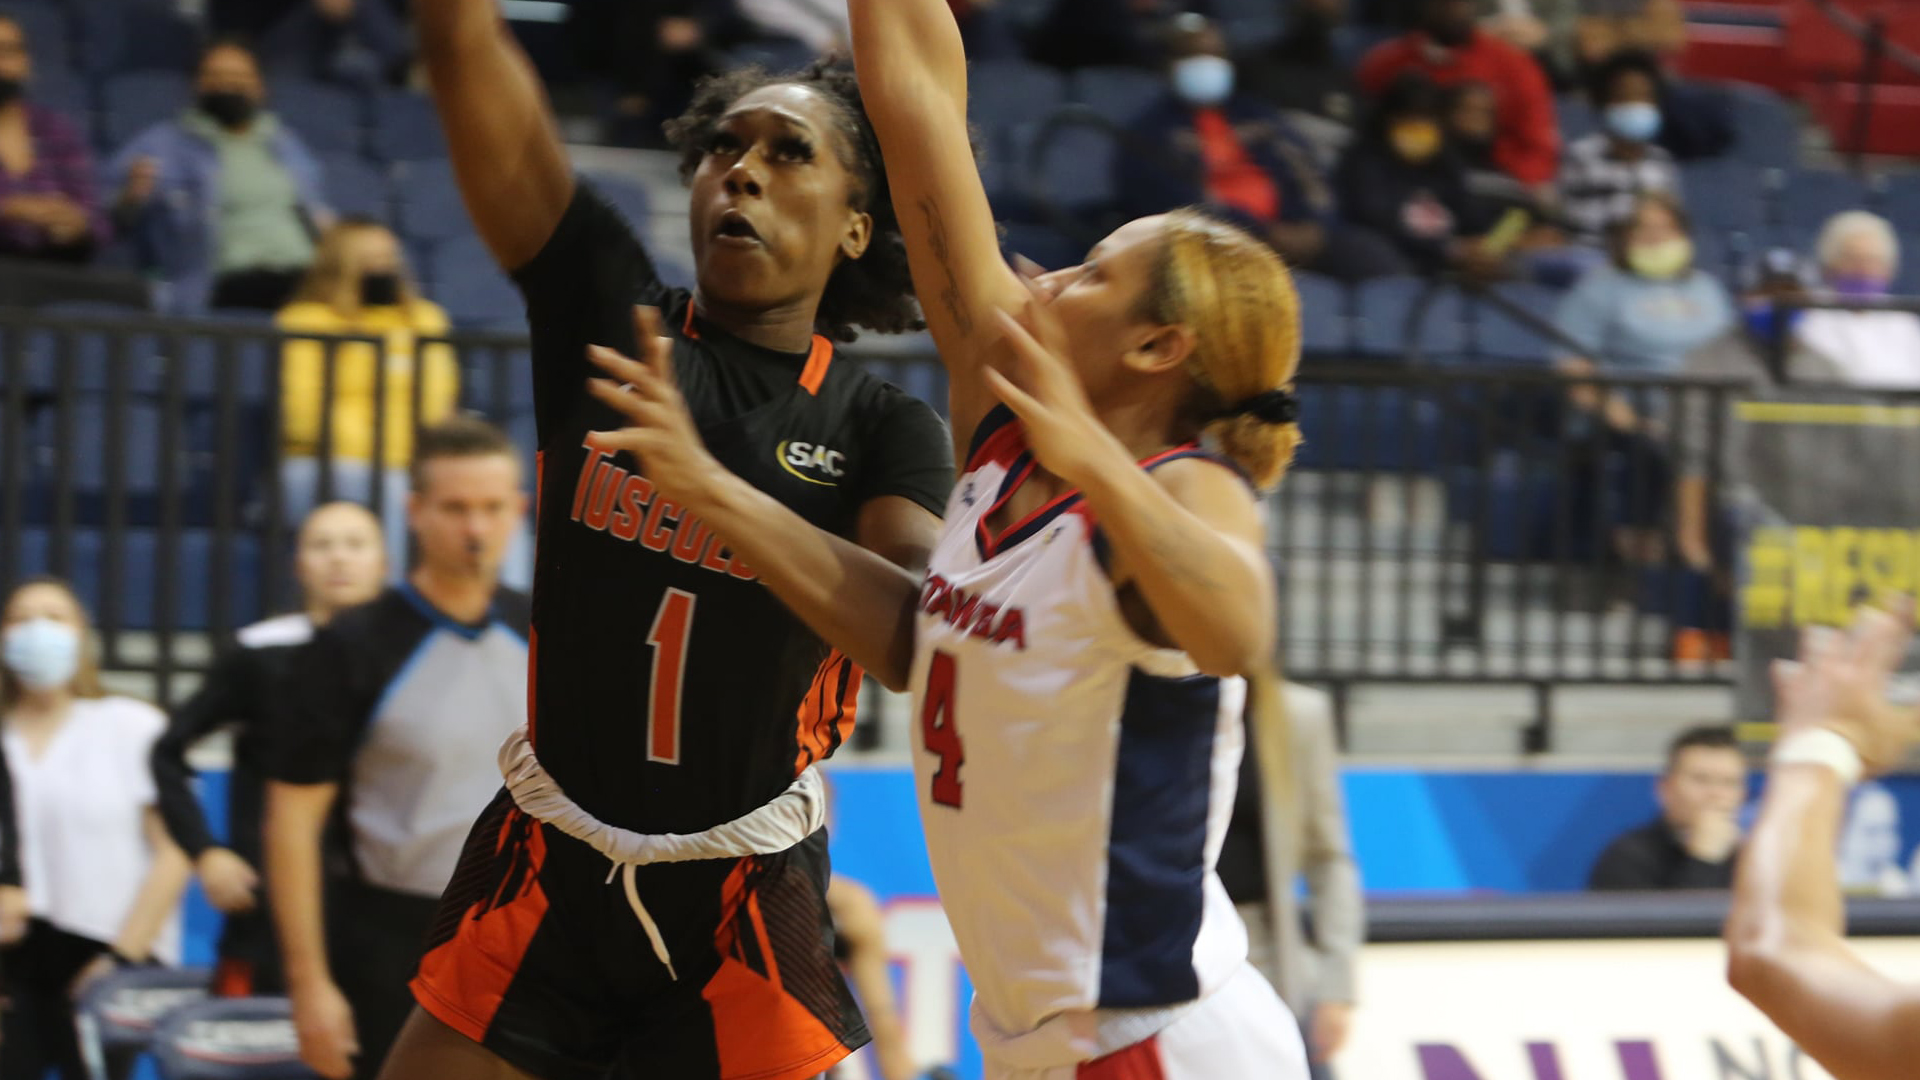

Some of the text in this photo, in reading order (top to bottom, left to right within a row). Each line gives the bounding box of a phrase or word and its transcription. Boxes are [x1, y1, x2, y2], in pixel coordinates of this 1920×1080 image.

[571, 430, 770, 585] TUSCUL
[786, 441, 846, 477] SAC
[646, 586, 696, 766] 1
[921, 569, 1026, 651] TAWBA
[923, 649, 964, 809] 4
